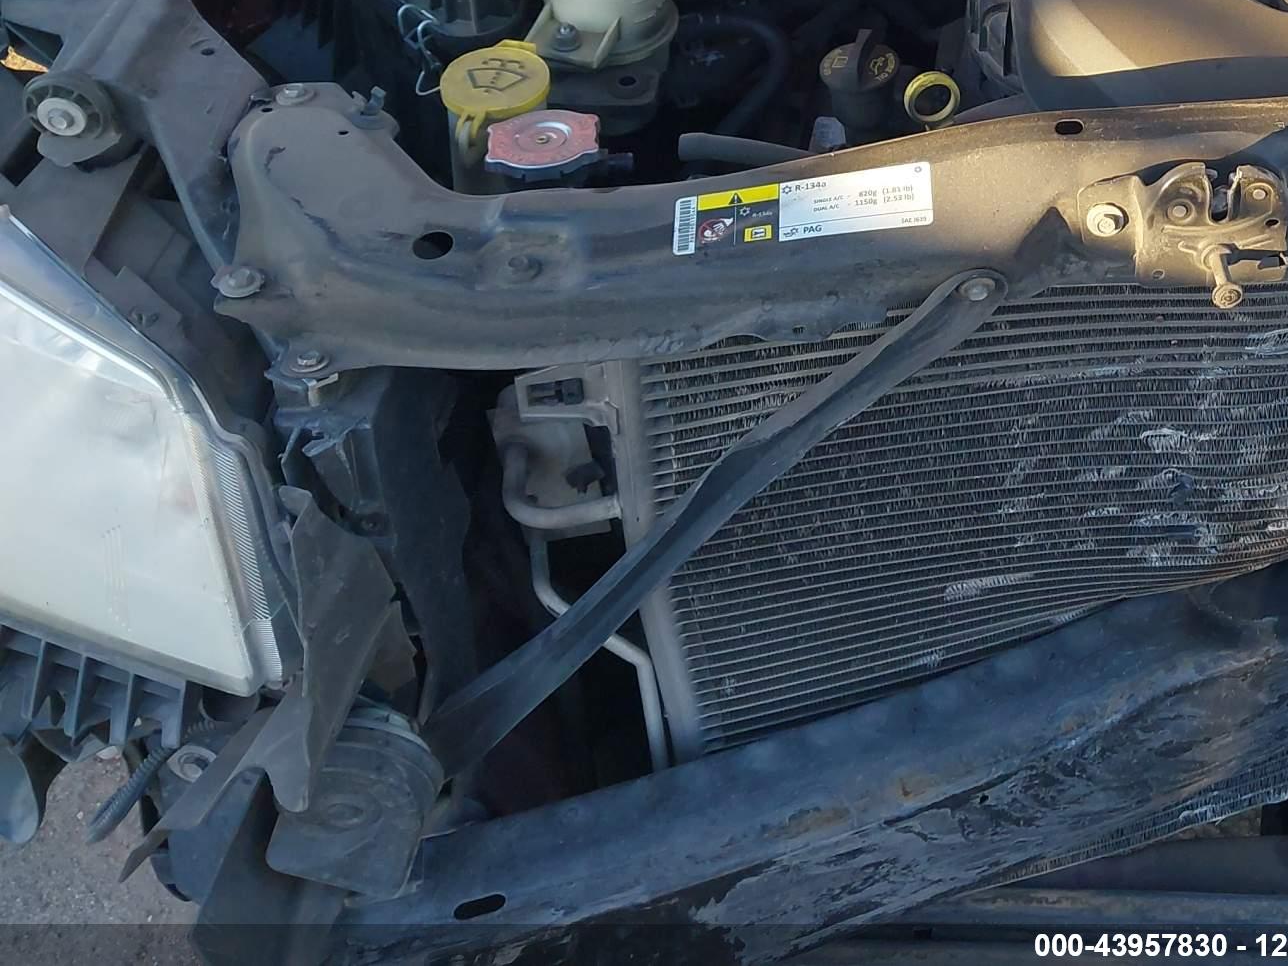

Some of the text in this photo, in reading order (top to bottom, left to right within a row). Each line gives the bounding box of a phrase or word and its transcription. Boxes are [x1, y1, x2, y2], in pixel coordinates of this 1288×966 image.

[794, 181, 827, 192] R-134a
[813, 205, 828, 213] DUAL
[854, 198, 878, 208] 1150g
[803, 224, 823, 234] PAG
